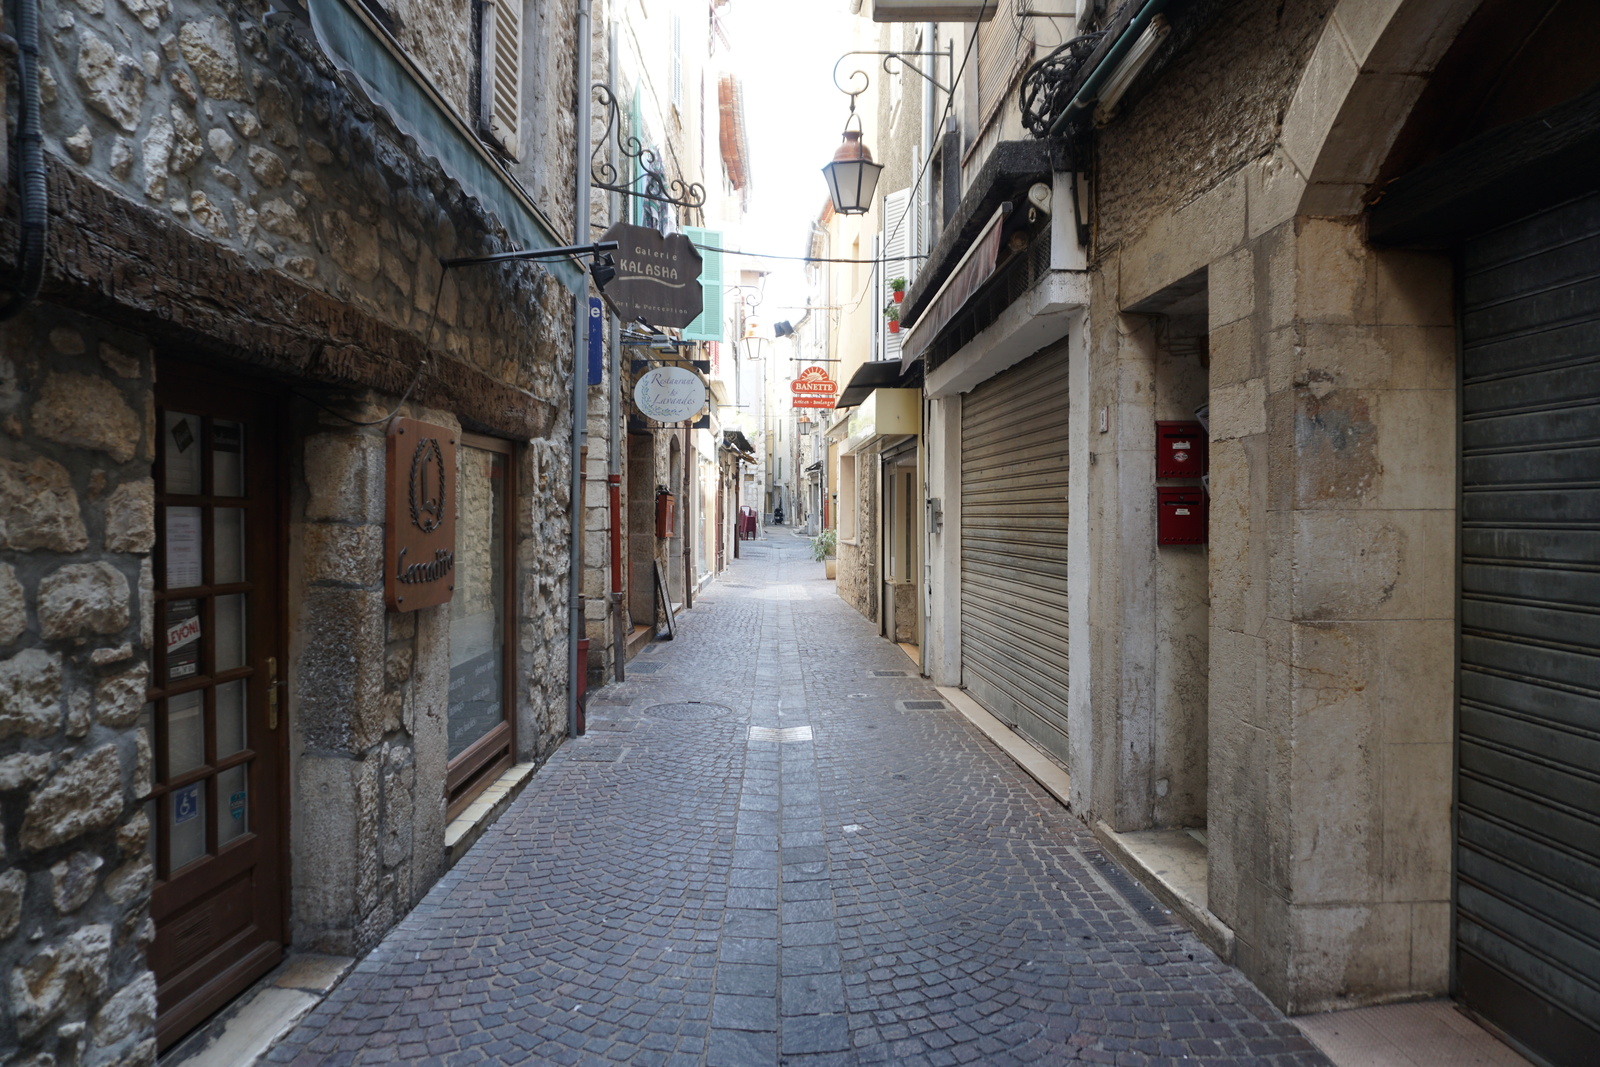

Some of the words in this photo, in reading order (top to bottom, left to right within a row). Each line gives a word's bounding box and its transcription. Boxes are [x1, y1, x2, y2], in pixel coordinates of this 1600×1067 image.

[635, 246, 678, 261] Galerie
[620, 259, 678, 280] KALASHA
[651, 373, 695, 387] Restaurant
[795, 383, 833, 391] BANETTE
[651, 389, 696, 405] Lavandes
[167, 620, 200, 646] LEVONI
